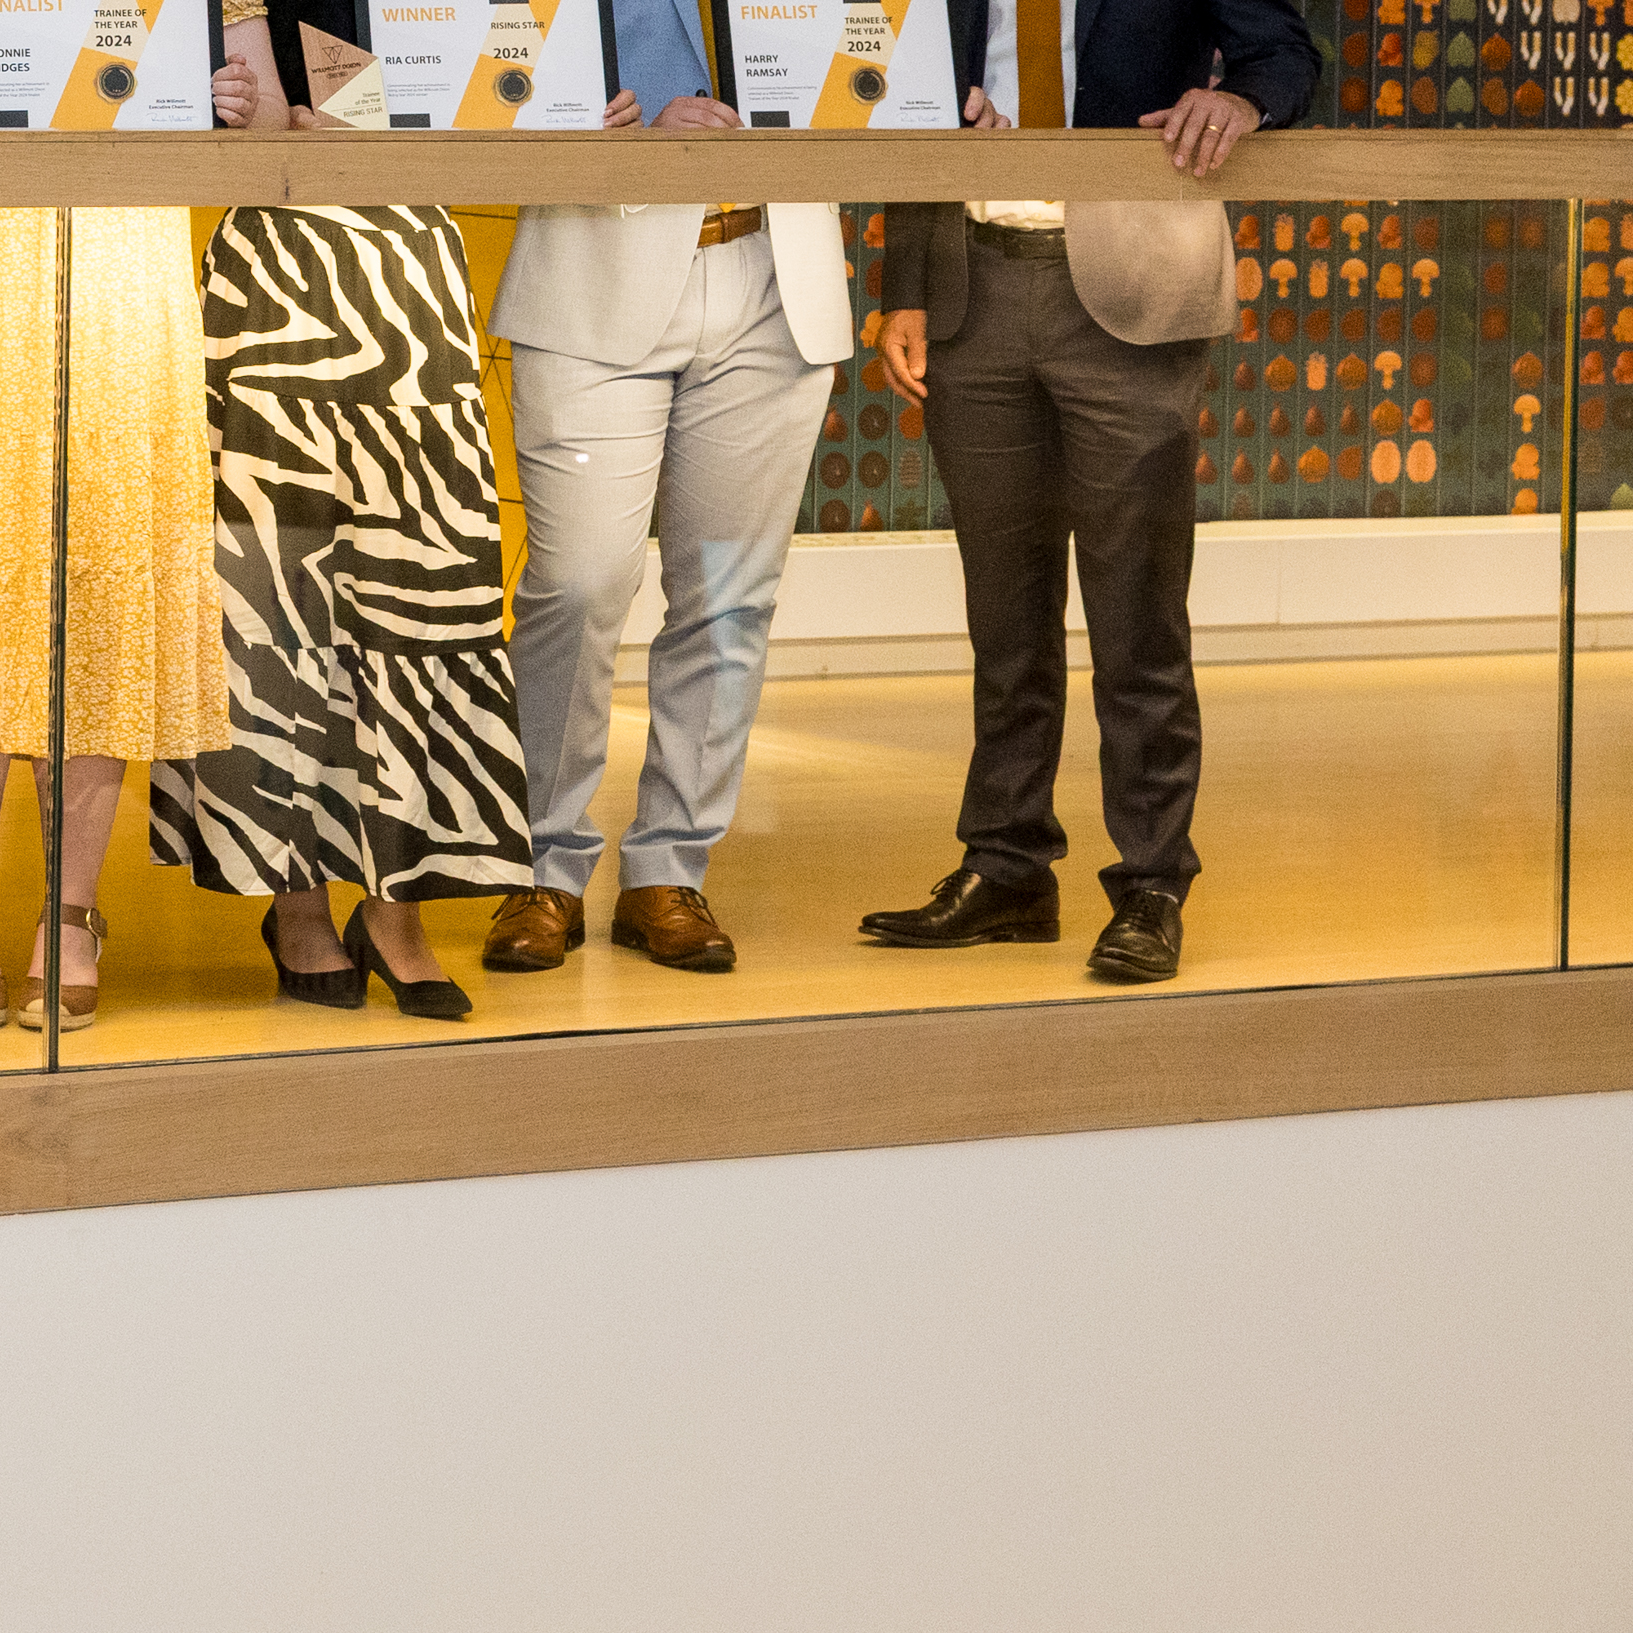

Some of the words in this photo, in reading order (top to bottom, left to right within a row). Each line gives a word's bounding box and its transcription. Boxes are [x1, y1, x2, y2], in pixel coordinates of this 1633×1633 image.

[94, 9, 133, 18] TRAINEE
[135, 8, 147, 16] OF
[383, 7, 456, 22] WINNER
[741, 5, 817, 20] FINALIST
[95, 21, 112, 29] THE
[114, 20, 138, 28] YEAR
[491, 21, 520, 30] RISING
[522, 20, 545, 30] STAR
[845, 16, 880, 25] TRAINEE
[882, 16, 893, 24] OF
[845, 28, 861, 36] THE
[96, 35, 133, 47] 2024
[847, 40, 881, 52] 2024
[493, 47, 529, 59] 2024
[385, 56, 402, 66] RIA
[405, 55, 441, 64] CURTIS
[745, 54, 779, 64] HARRY
[746, 68, 788, 77] RAMSAY
[343, 109, 365, 118] RISING
[367, 106, 383, 114] STAR
